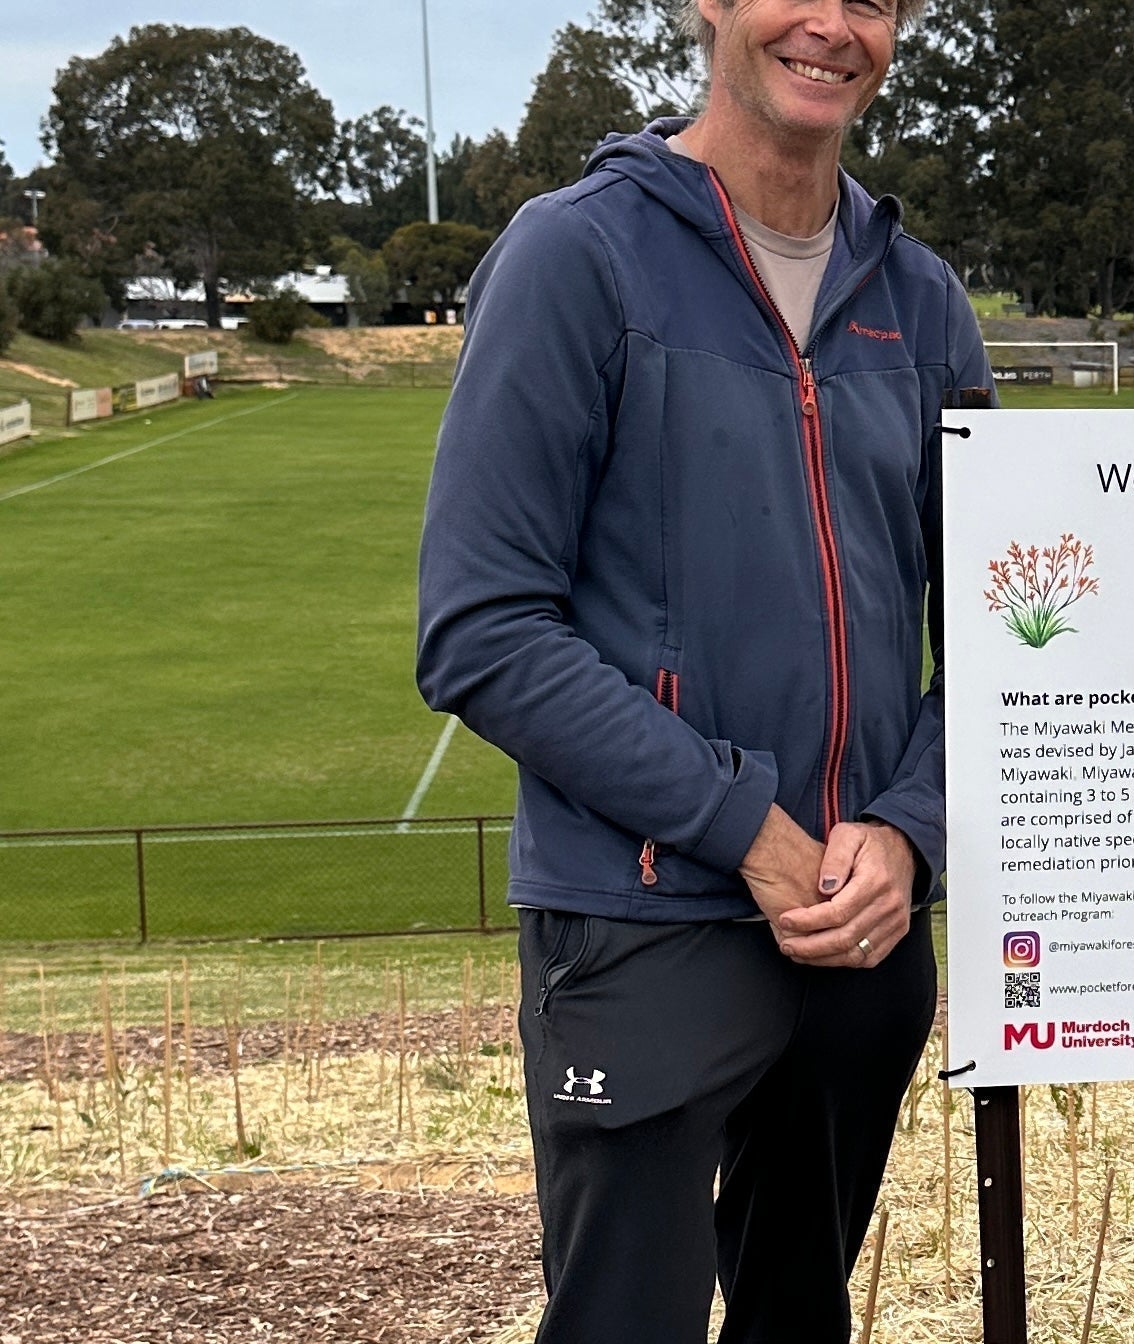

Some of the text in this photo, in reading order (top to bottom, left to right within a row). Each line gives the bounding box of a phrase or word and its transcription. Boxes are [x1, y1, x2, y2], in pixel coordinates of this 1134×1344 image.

[1001, 690, 1050, 707] What
[1054, 693, 1084, 706] are
[999, 721, 1029, 736] The
[1034, 719, 1106, 739] Miyawaki
[999, 747, 1031, 759] was
[1035, 742, 1094, 758] devised
[1099, 742, 1118, 761] by
[1001, 856, 1096, 872] remediation
[1001, 894, 1017, 905] To
[1018, 892, 1056, 905] follow
[1057, 891, 1078, 904] the
[1002, 909, 1058, 923] Outreach
[1061, 1019, 1130, 1034] Murdoch
[1004, 1021, 1056, 1051] MU
